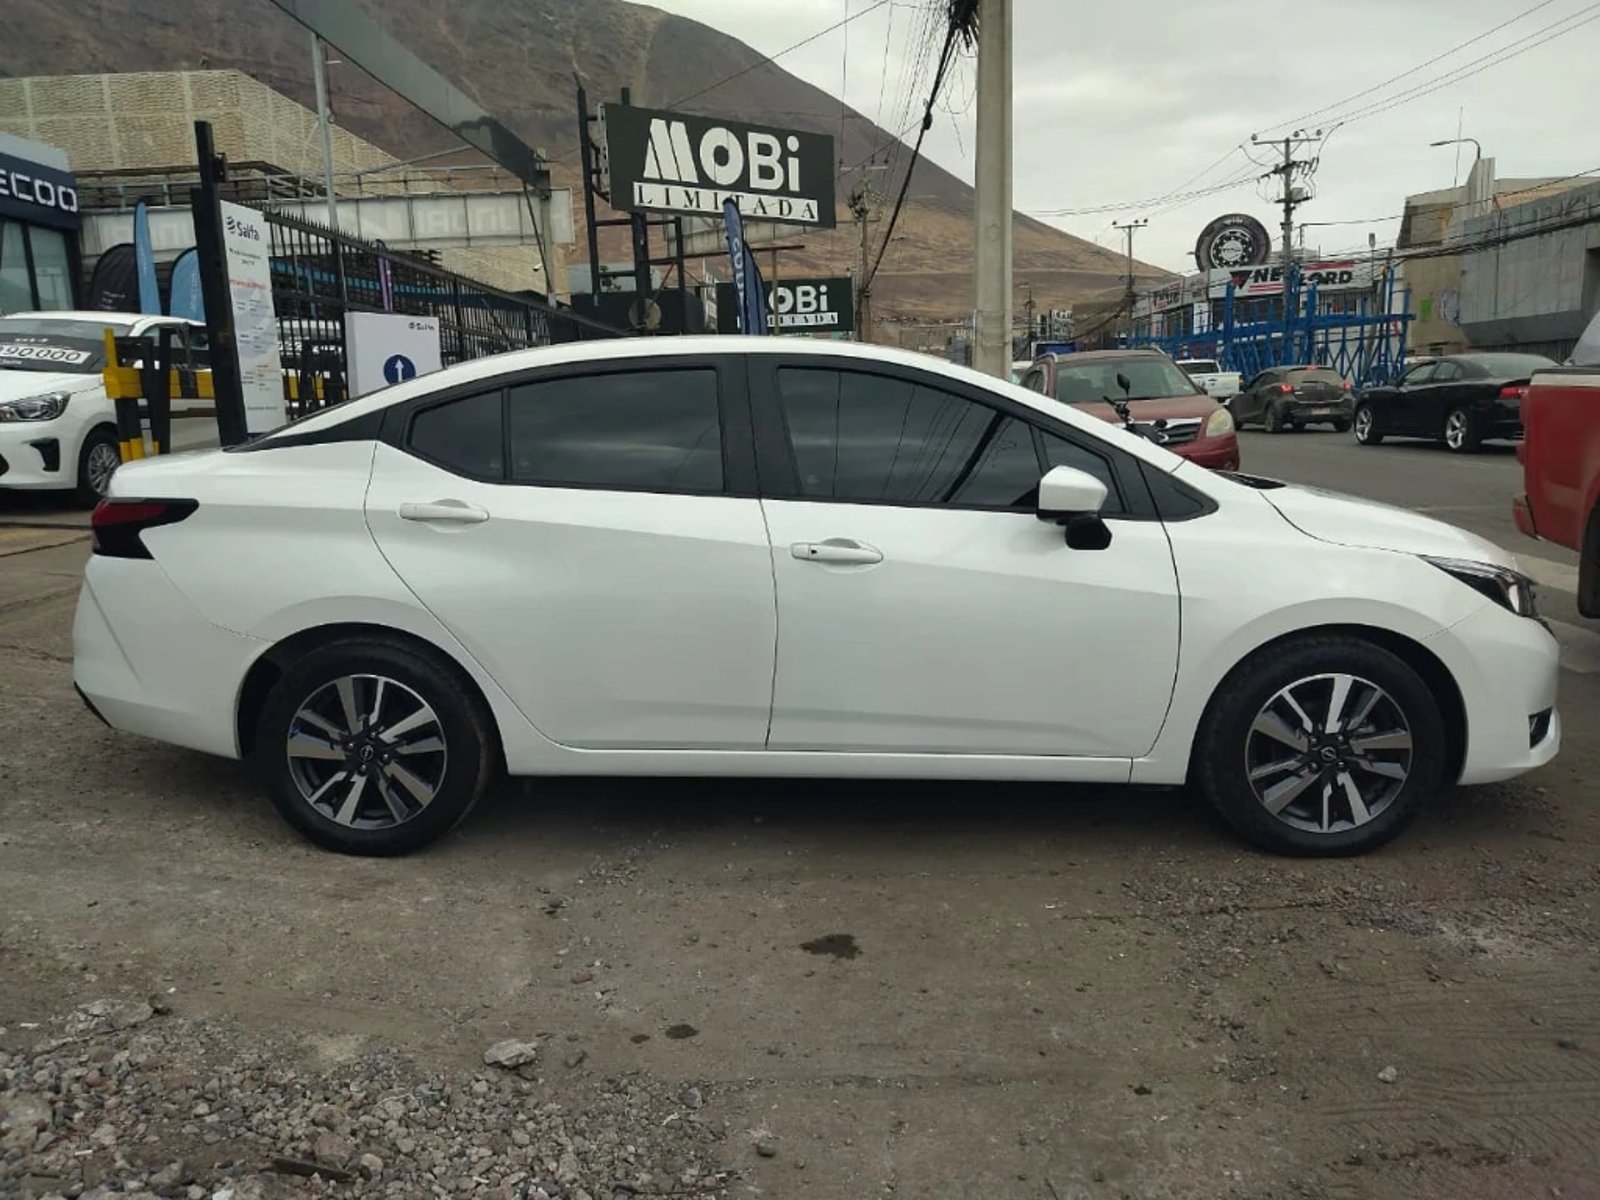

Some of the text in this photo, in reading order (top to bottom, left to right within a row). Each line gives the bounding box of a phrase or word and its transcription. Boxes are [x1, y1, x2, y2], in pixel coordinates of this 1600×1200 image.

[643, 118, 800, 192] MOBi
[638, 185, 816, 220] LIMITADA
[236, 221, 260, 241] Salfa
[768, 285, 828, 313] OBi
